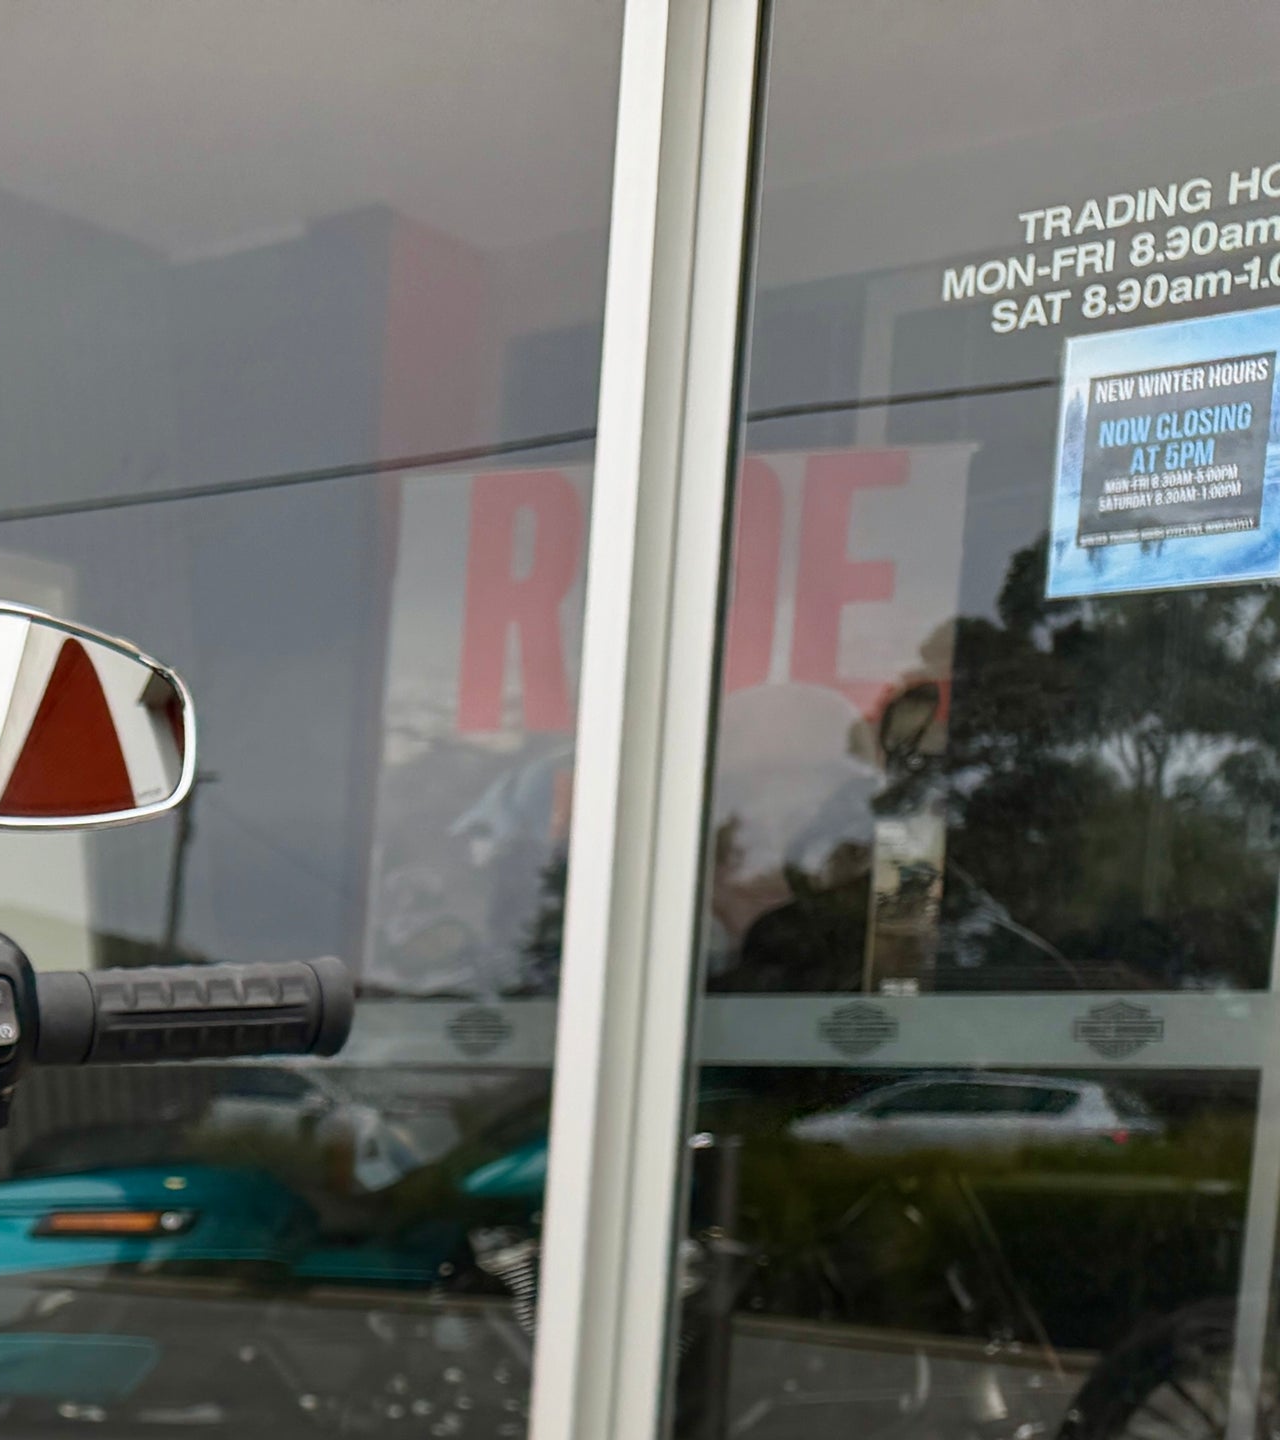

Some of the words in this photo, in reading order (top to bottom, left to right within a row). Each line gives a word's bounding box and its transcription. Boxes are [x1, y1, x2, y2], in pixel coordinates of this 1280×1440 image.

[1018, 177, 1213, 244] TRADING
[942, 238, 1115, 301] MON-FRI
[990, 289, 1072, 333] SAT
[1095, 378, 1134, 404] NEW
[1138, 367, 1206, 398] WINTER
[1208, 357, 1269, 388] HOURS
[1098, 414, 1152, 448] NOW
[1156, 401, 1253, 441] CLOSING
[1130, 446, 1161, 474] AT
[1098, 489, 1152, 512] SATURDAY
[458, 449, 911, 734] RE
